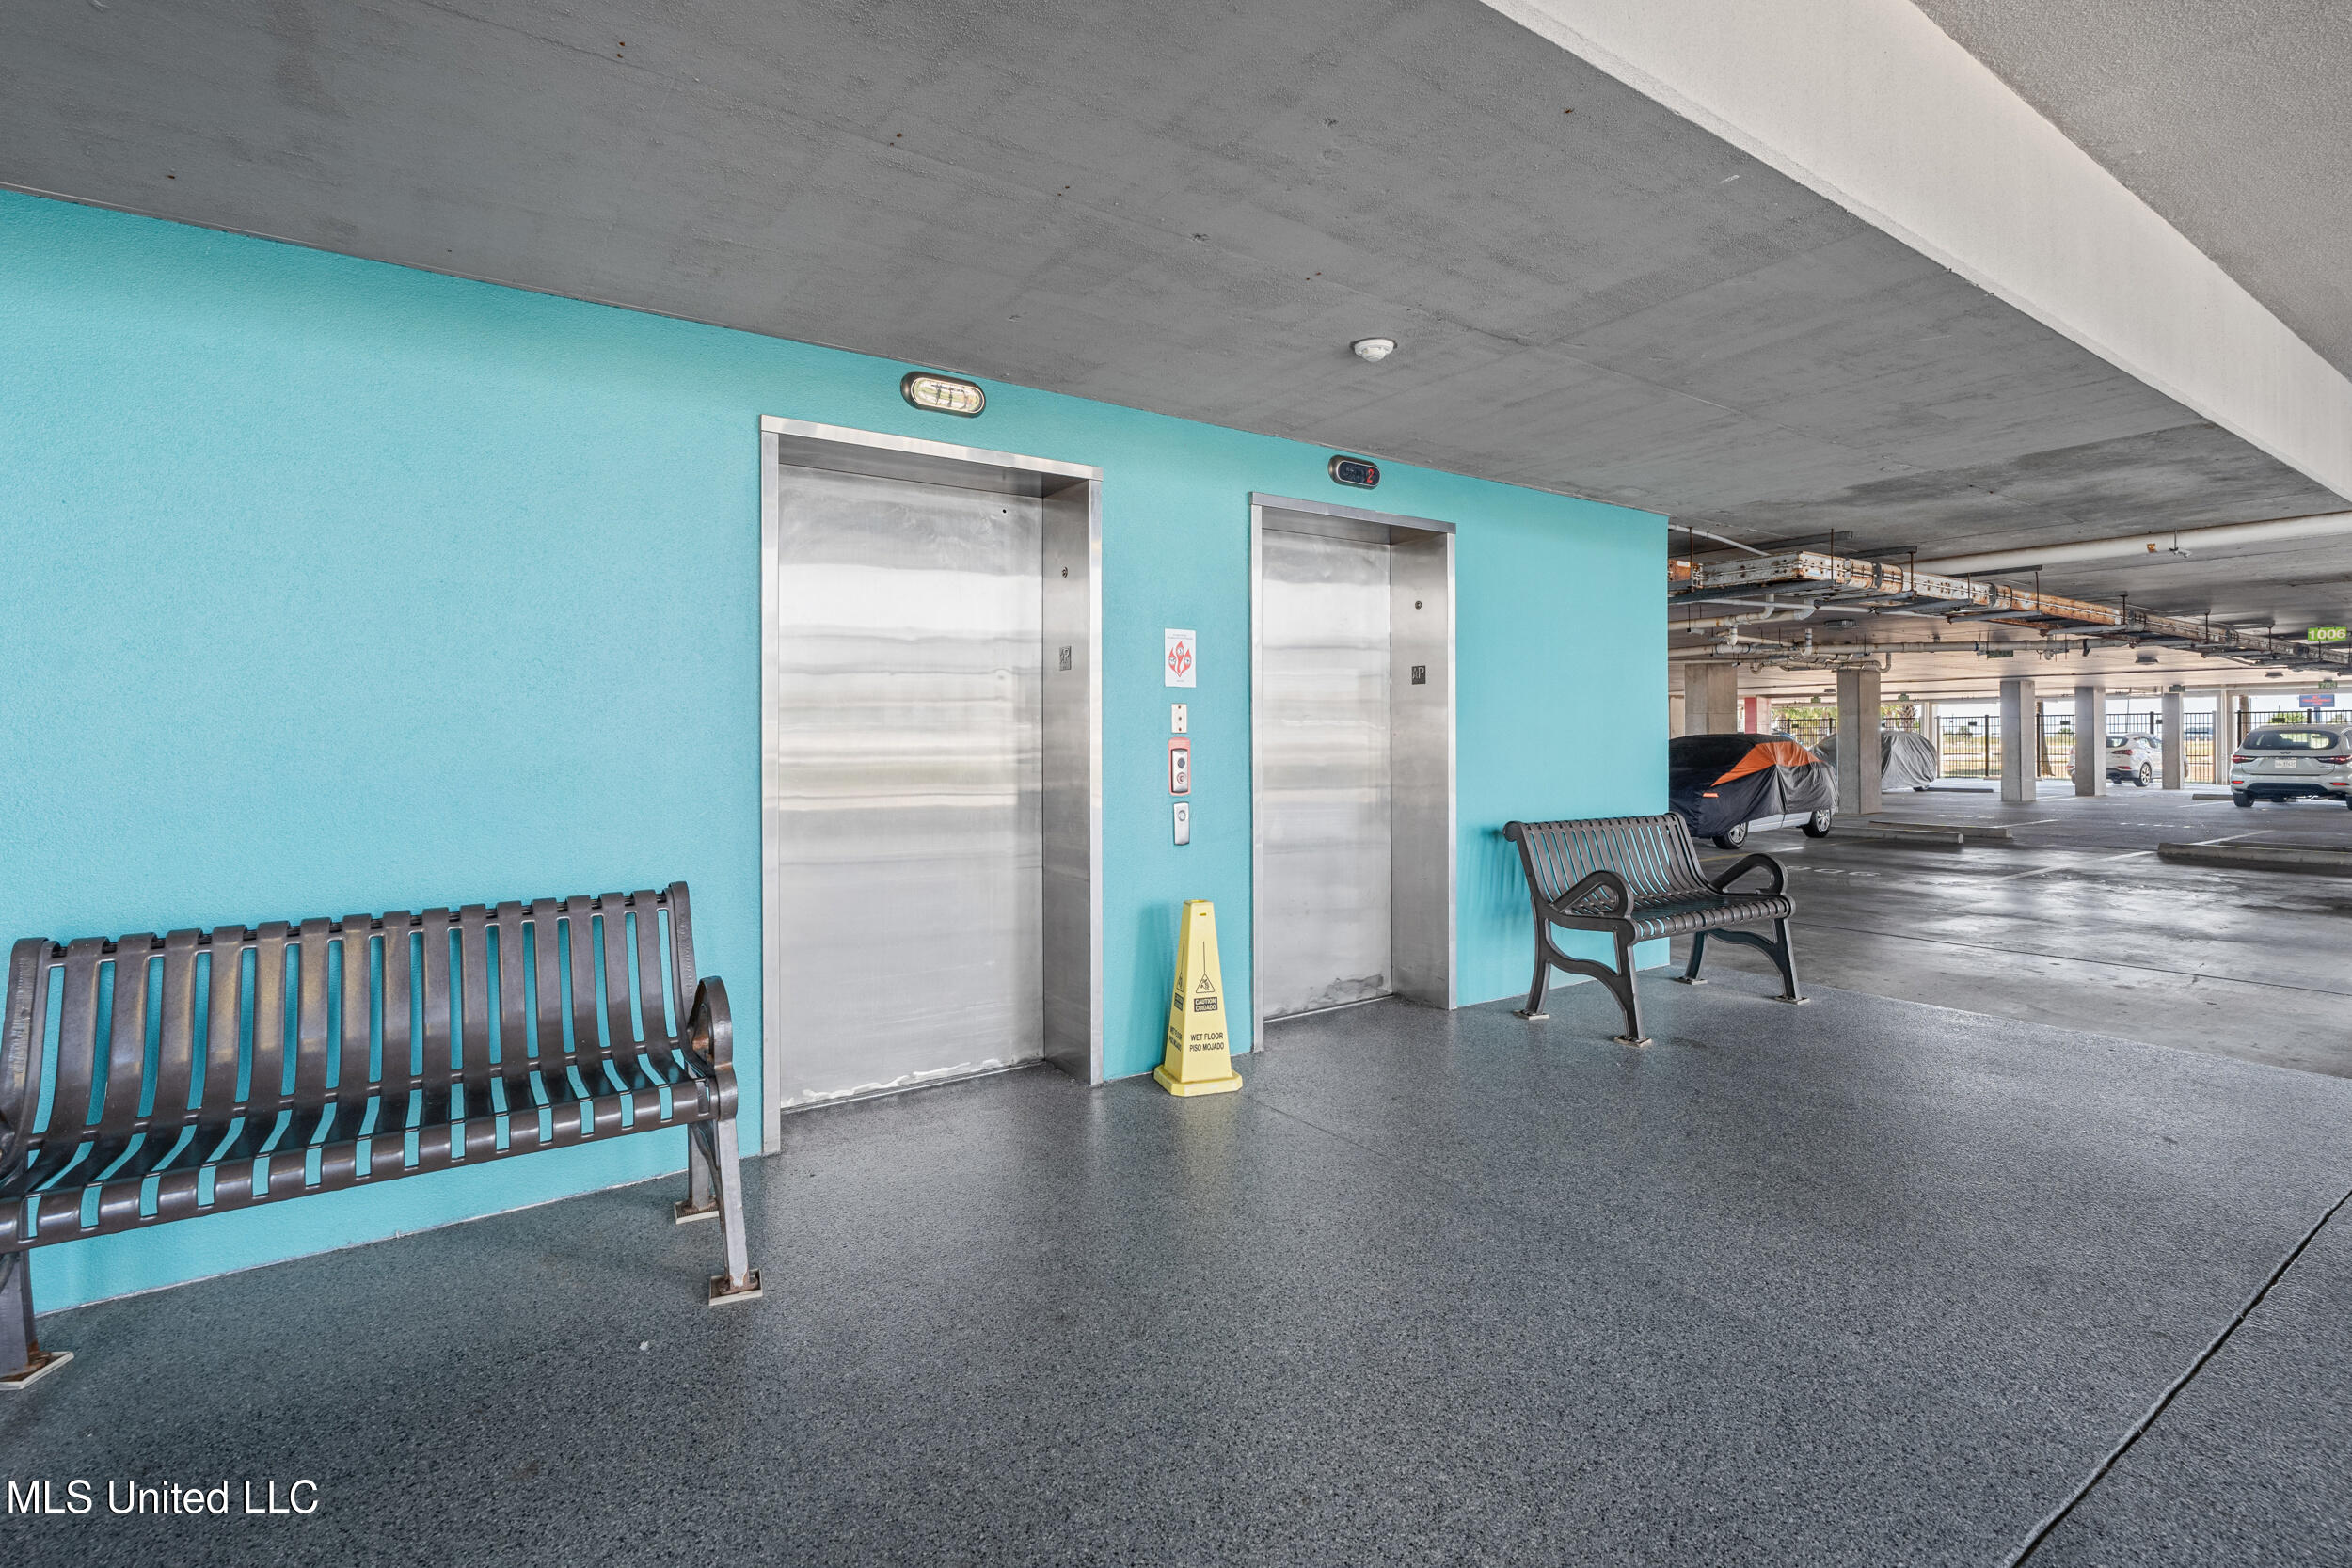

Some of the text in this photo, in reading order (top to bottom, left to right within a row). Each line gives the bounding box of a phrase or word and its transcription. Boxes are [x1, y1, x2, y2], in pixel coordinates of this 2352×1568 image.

[1366, 468, 1375, 483] 2
[2309, 628, 2346, 640] 1006
[1190, 1032, 1224, 1041] WET FLOOR
[1189, 1043, 1202, 1052] PISO
[1202, 1042, 1225, 1051] MOJADO
